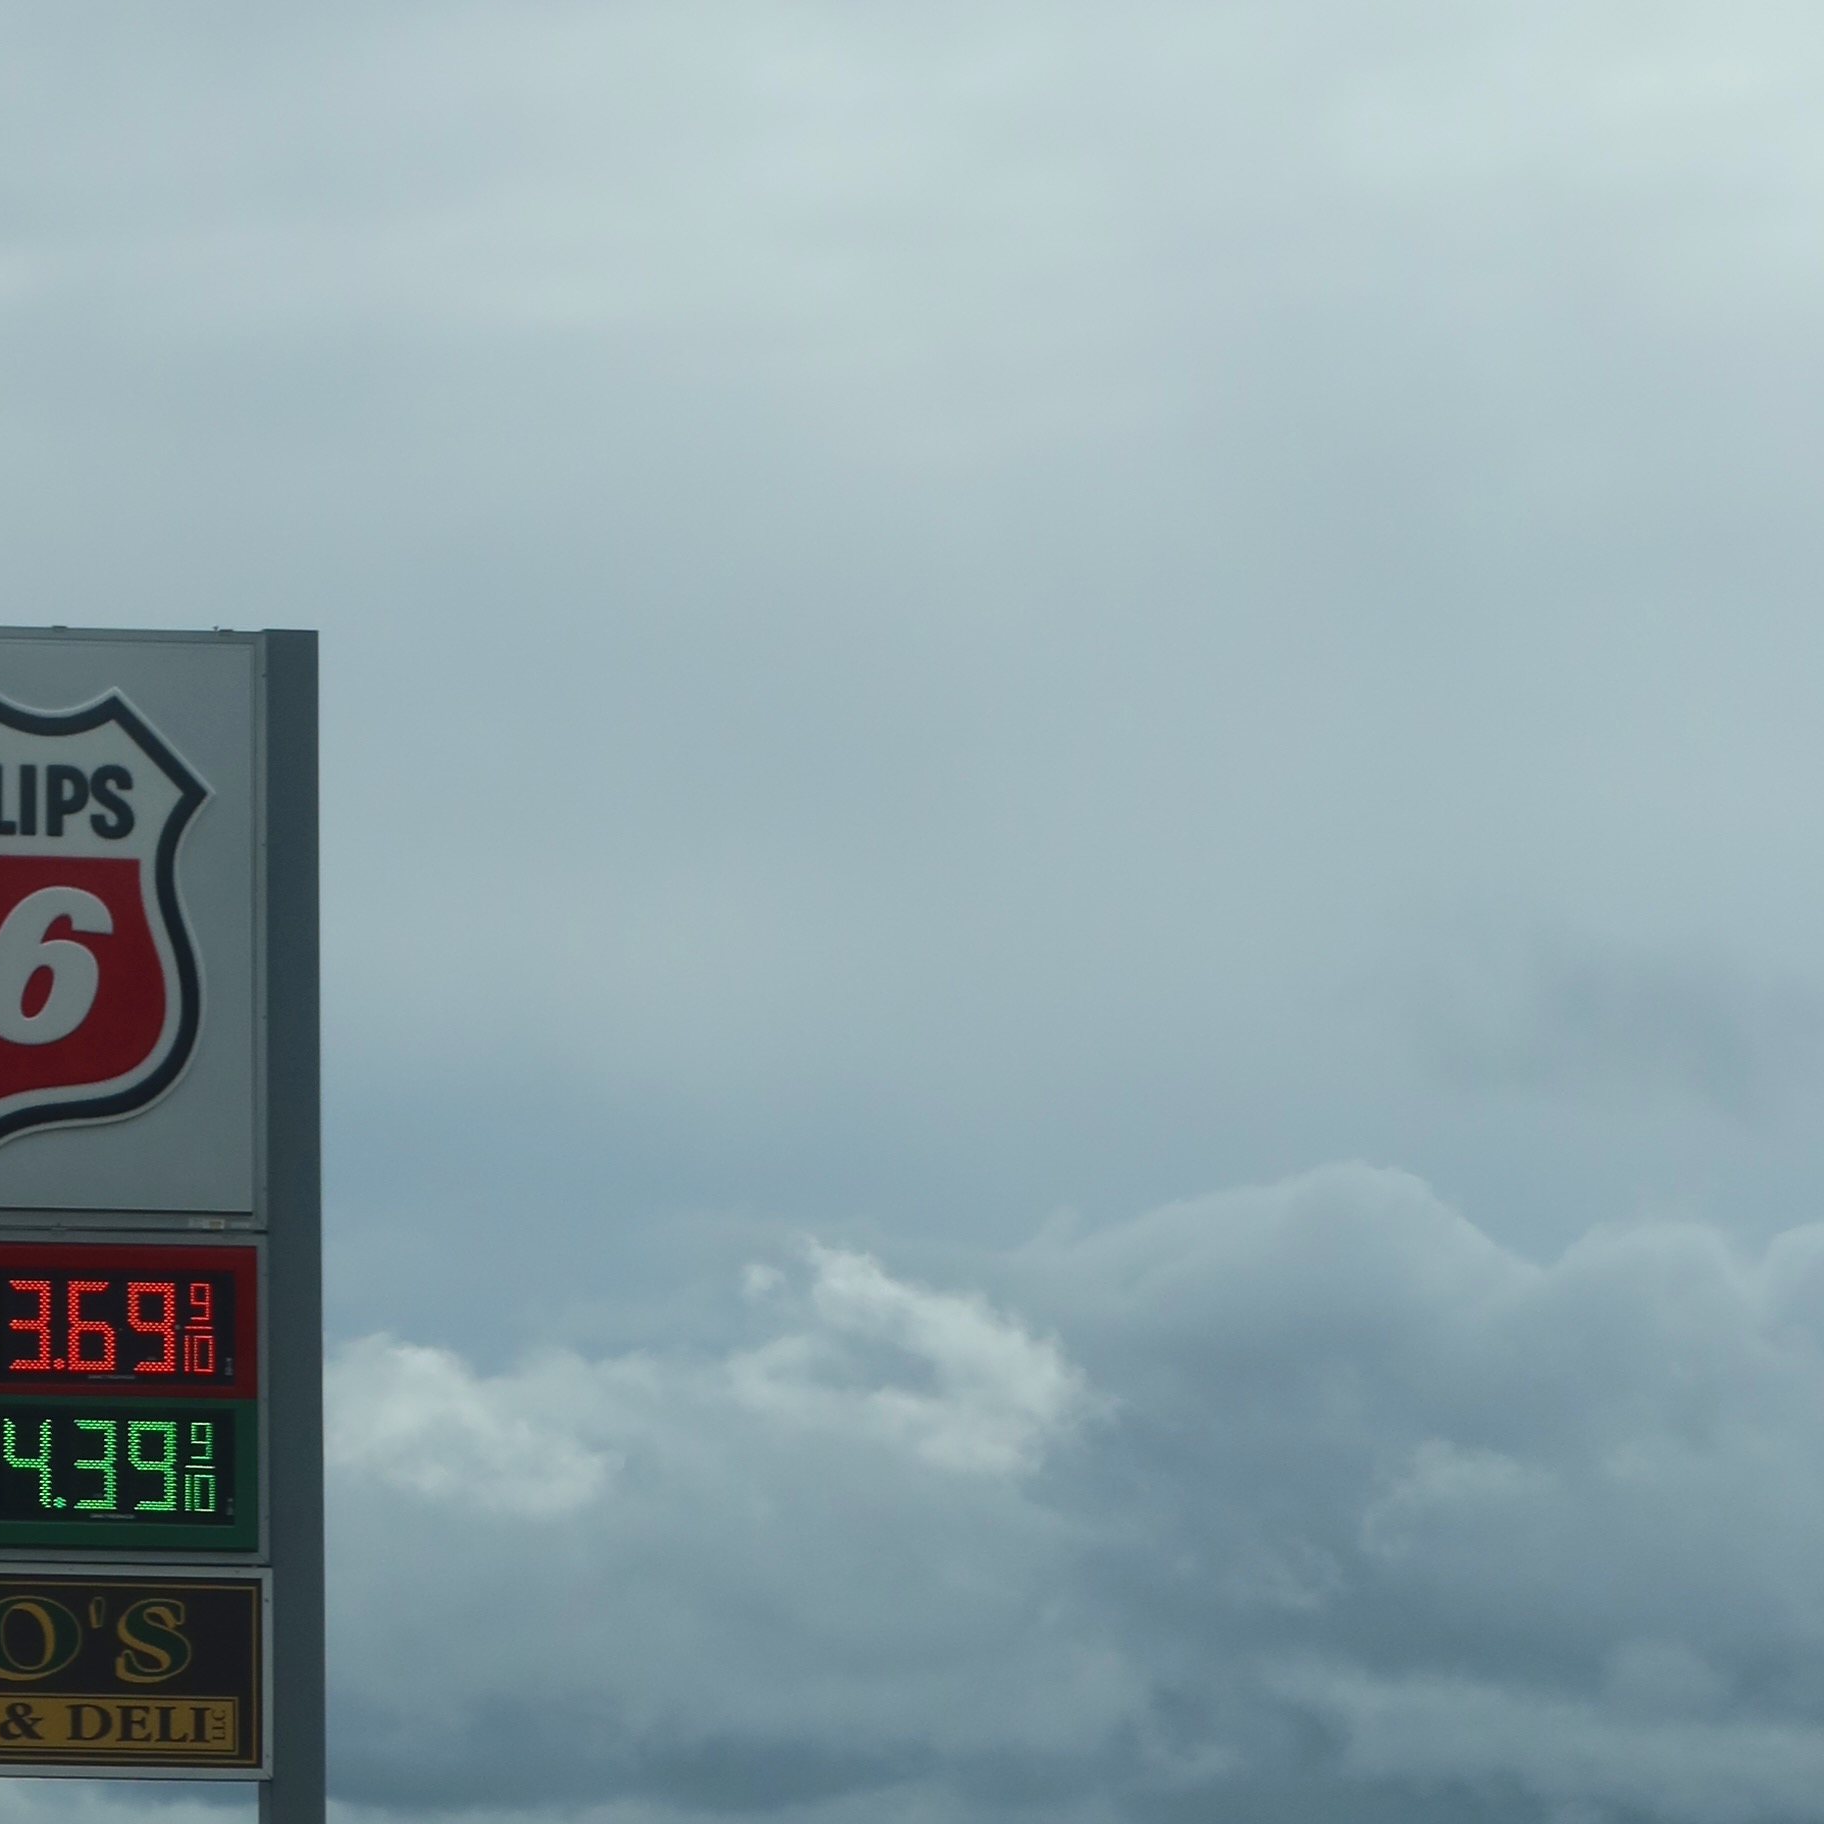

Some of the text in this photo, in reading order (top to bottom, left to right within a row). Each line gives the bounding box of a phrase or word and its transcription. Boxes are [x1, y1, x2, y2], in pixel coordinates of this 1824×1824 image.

[9, 1279, 176, 1373] 3.69
[2, 1417, 178, 1512] 4.39
[66, 1704, 212, 1744] DELI
[210, 1709, 226, 1741] LLC
